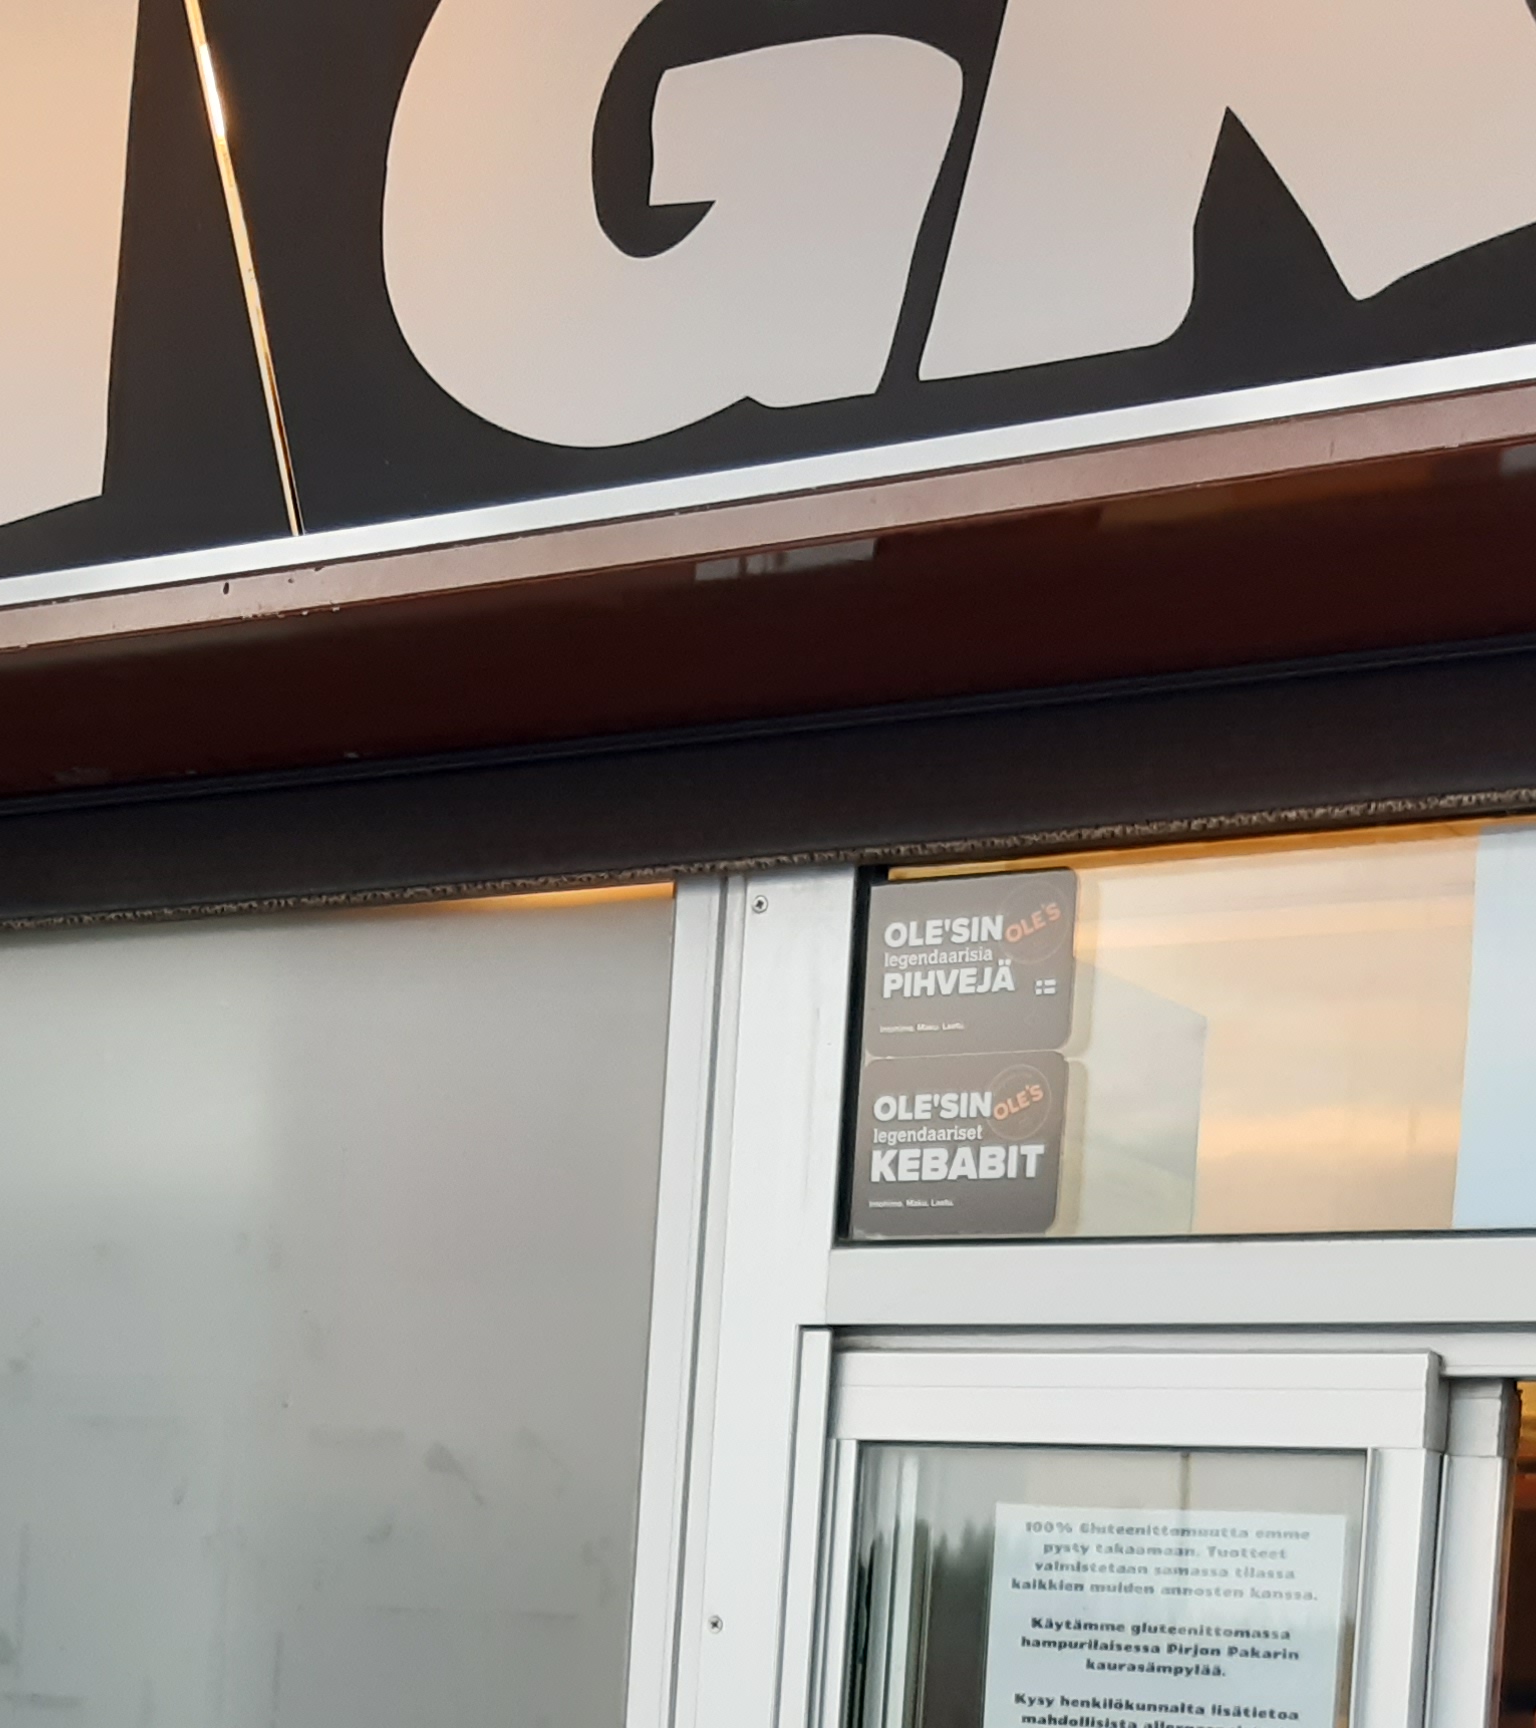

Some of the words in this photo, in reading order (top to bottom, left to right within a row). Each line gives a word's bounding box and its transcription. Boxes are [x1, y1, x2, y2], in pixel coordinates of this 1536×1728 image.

[884, 915, 1004, 947] OLE'SIN
[1005, 902, 1061, 944] OLE'S
[884, 947, 993, 970] legendaarisia
[882, 958, 1015, 998] PIHVEJÄ
[873, 1092, 993, 1121] OLE'SIN
[993, 1084, 1044, 1120] OLE'S
[873, 1124, 983, 1146] legendaariset
[870, 1145, 1045, 1182] KEBABIT
[1025, 1521, 1073, 1535] 100%
[1043, 1541, 1090, 1556] pysty
[1011, 1578, 1085, 1592] kaikkien
[1030, 1616, 1126, 1635] Käytämme
[1020, 1636, 1161, 1655] hampurilaisessa
[1227, 1645, 1300, 1661] Pakarin
[1085, 1658, 1227, 1679] kaurasämpylää.
[1014, 1692, 1055, 1709] Kysy
[1060, 1694, 1206, 1717] henkilökunnalta
[1210, 1703, 1300, 1722] lisätietoa
